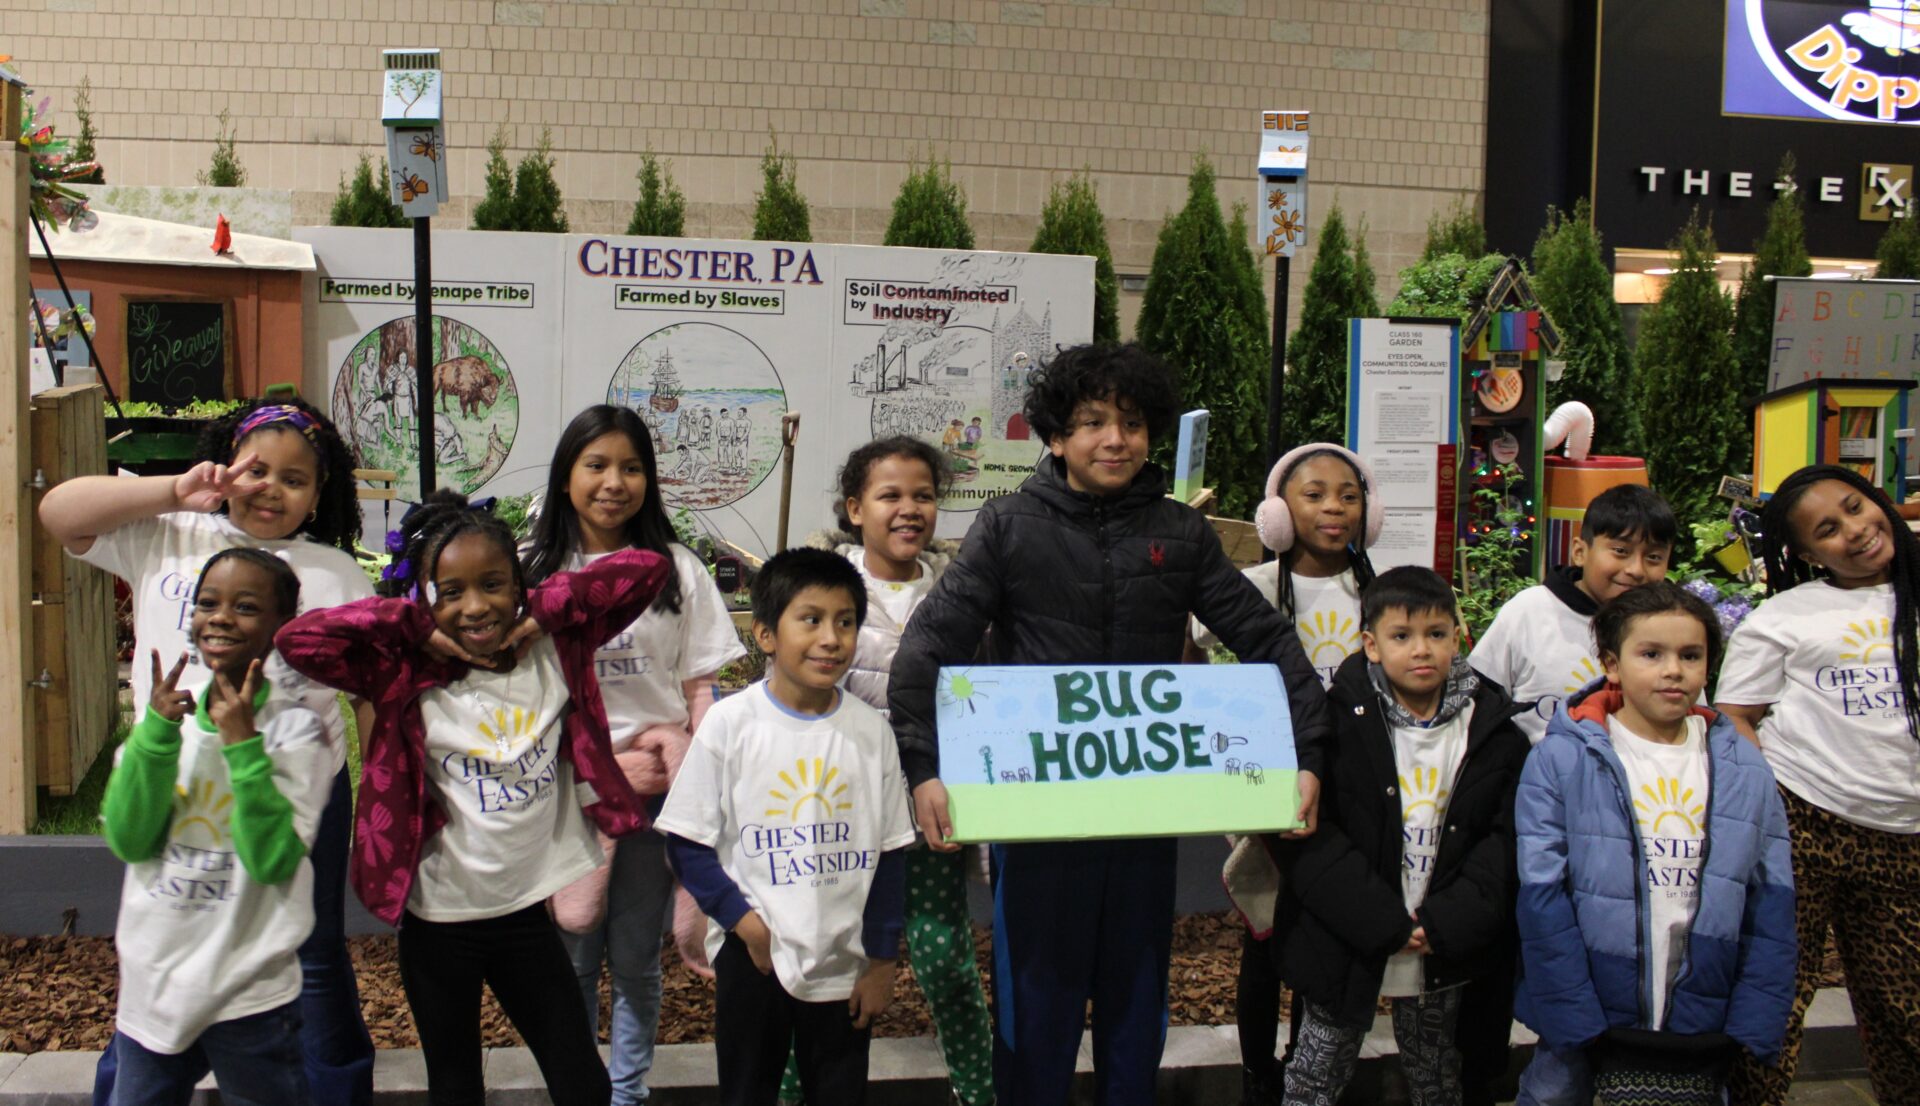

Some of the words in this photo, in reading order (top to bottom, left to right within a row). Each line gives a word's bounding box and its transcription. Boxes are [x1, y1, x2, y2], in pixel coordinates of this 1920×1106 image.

[1641, 166, 1753, 198] THE
[578, 238, 763, 285] CHESTER,
[770, 247, 825, 286] PA
[325, 280, 392, 297] Farmed
[397, 282, 416, 300] by
[431, 285, 483, 302] enape
[487, 285, 530, 301] Tribe
[619, 287, 691, 305] Farmed
[694, 290, 718, 309] by
[720, 291, 781, 308] Slaves
[849, 282, 881, 298] Soil
[883, 284, 1010, 304] Contaminated
[1776, 291, 1797, 322] A
[1812, 290, 1833, 321] B
[1846, 290, 1866, 318] C
[1883, 291, 1905, 320] D
[851, 299, 867, 312] by
[873, 303, 954, 325] Industry
[132, 317, 221, 384] Giveaway
[1389, 338, 1423, 347] GARDEN
[1773, 337, 1794, 363] F
[1843, 335, 1862, 366] H
[983, 463, 1006, 473] HOME
[1008, 464, 1036, 474] GROWN
[945, 486, 1016, 500] mmunit
[1052, 669, 1183, 725] BUG
[1841, 686, 1905, 717] EAST
[1028, 721, 1213, 783] HOUSE
[740, 821, 850, 859] CHESTER
[768, 849, 877, 887] EASTSIDE
